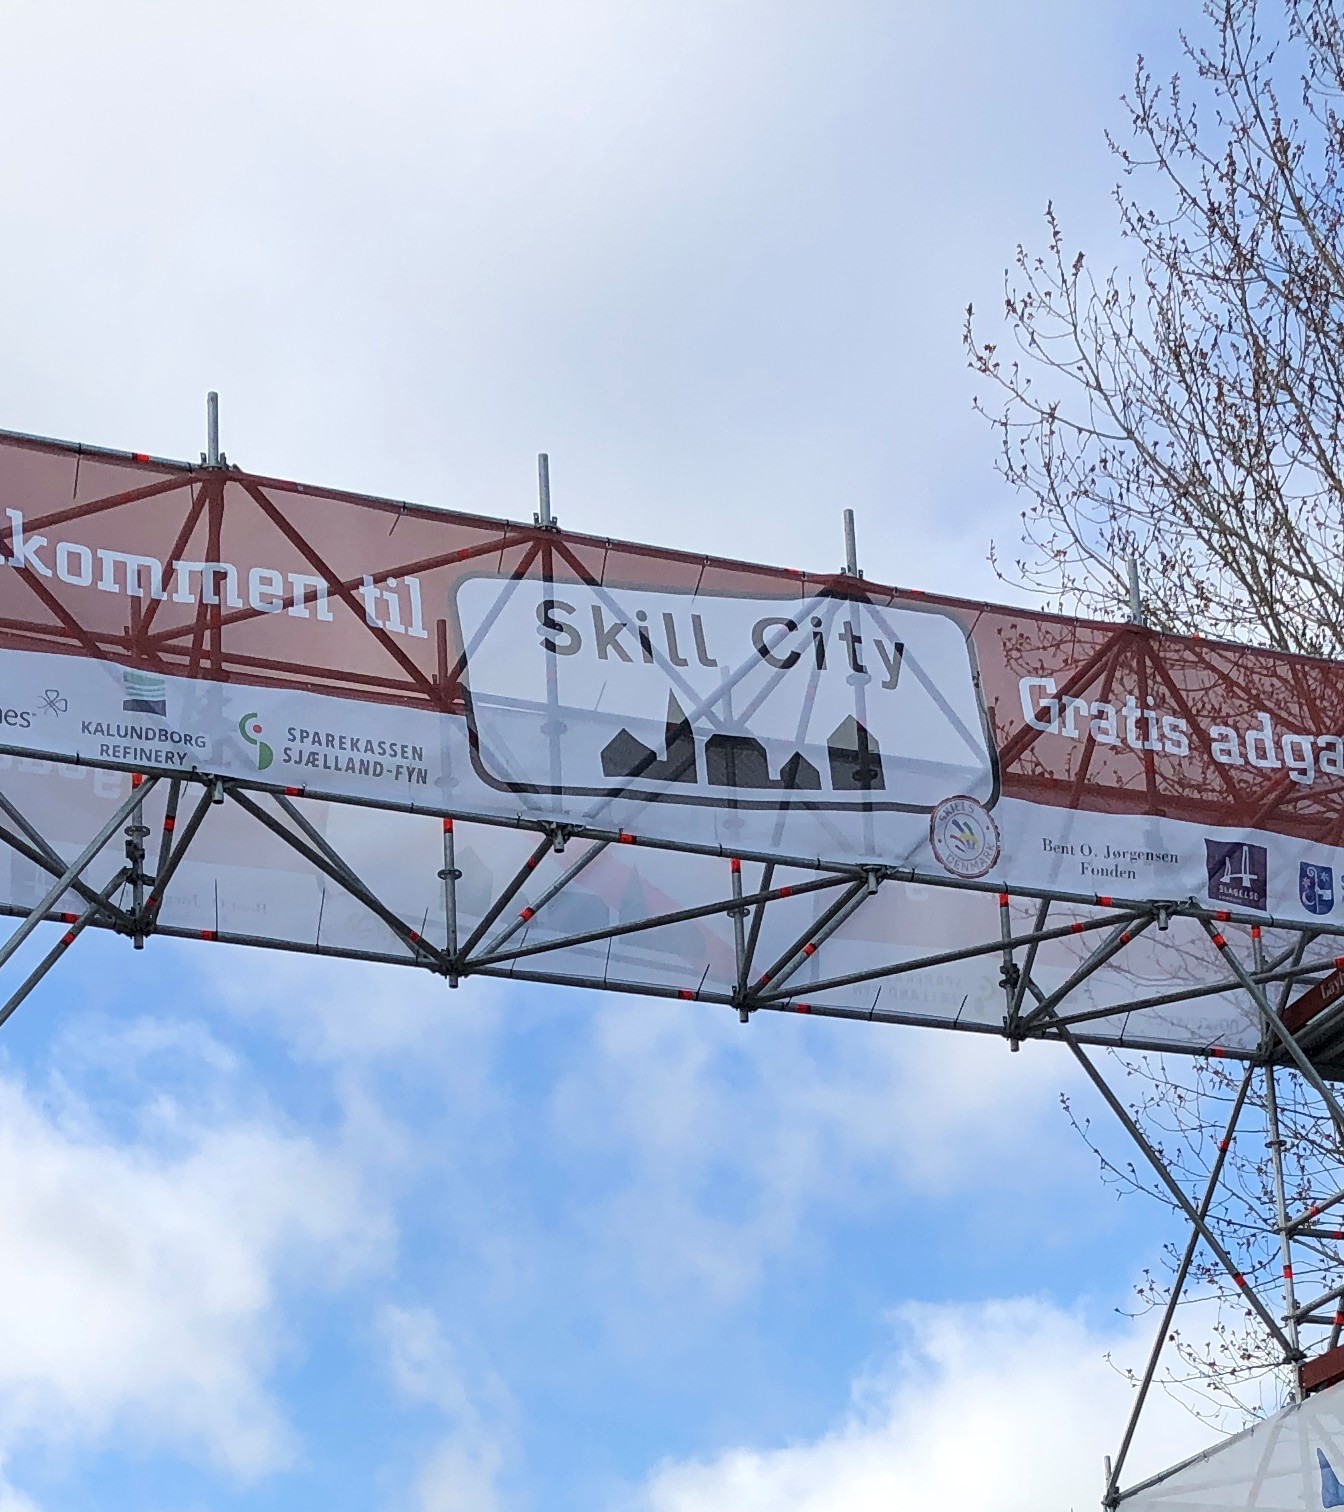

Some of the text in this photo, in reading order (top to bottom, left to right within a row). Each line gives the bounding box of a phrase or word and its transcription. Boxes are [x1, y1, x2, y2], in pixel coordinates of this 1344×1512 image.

[358, 573, 429, 640] til
[534, 599, 906, 692] Skill City
[1017, 676, 1190, 757] Gratis
[81, 720, 207, 749] KALUNDBORG
[286, 725, 425, 762] SPAREKASSEN
[99, 743, 189, 767] REFINERY
[281, 745, 430, 786] SJÆLLAND-FYN
[938, 801, 976, 822] SKILLS
[945, 842, 996, 872] DENMARK
[1041, 836, 1180, 865] Bent O. Jørgensen
[1080, 861, 1137, 880] Fonden
